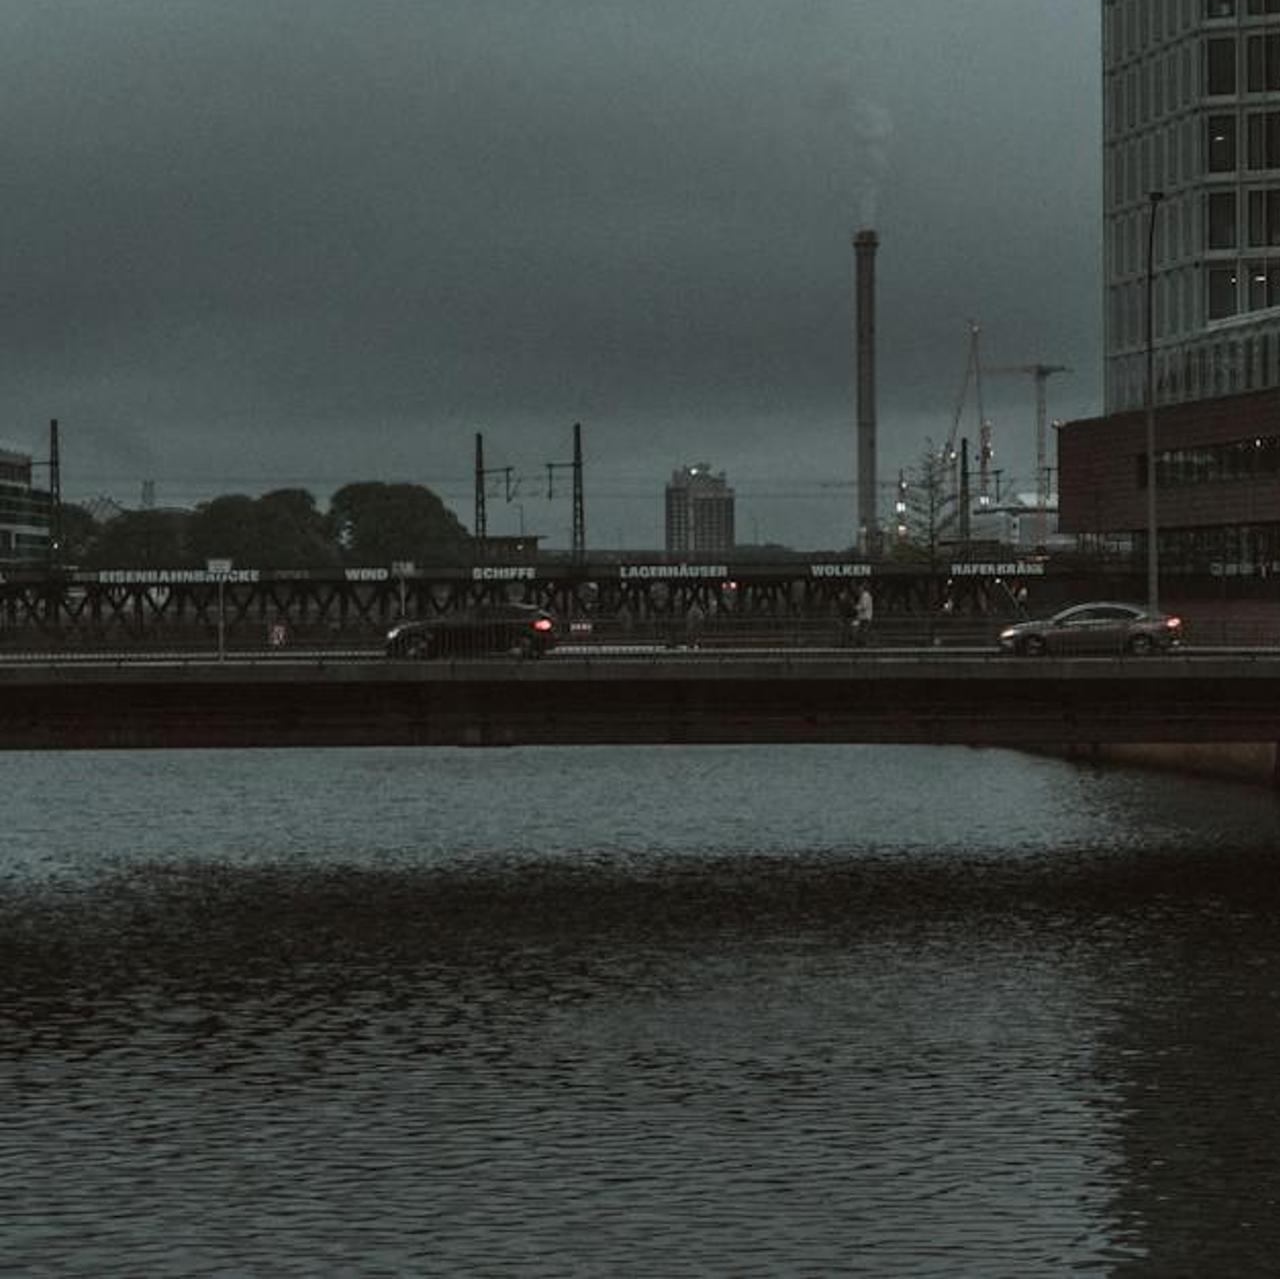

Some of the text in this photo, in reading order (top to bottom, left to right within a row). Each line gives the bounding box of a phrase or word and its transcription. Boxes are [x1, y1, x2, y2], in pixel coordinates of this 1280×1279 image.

[344, 568, 388, 581] WIND
[472, 567, 536, 580] SCHIFFE
[811, 565, 871, 577] WOLKEN
